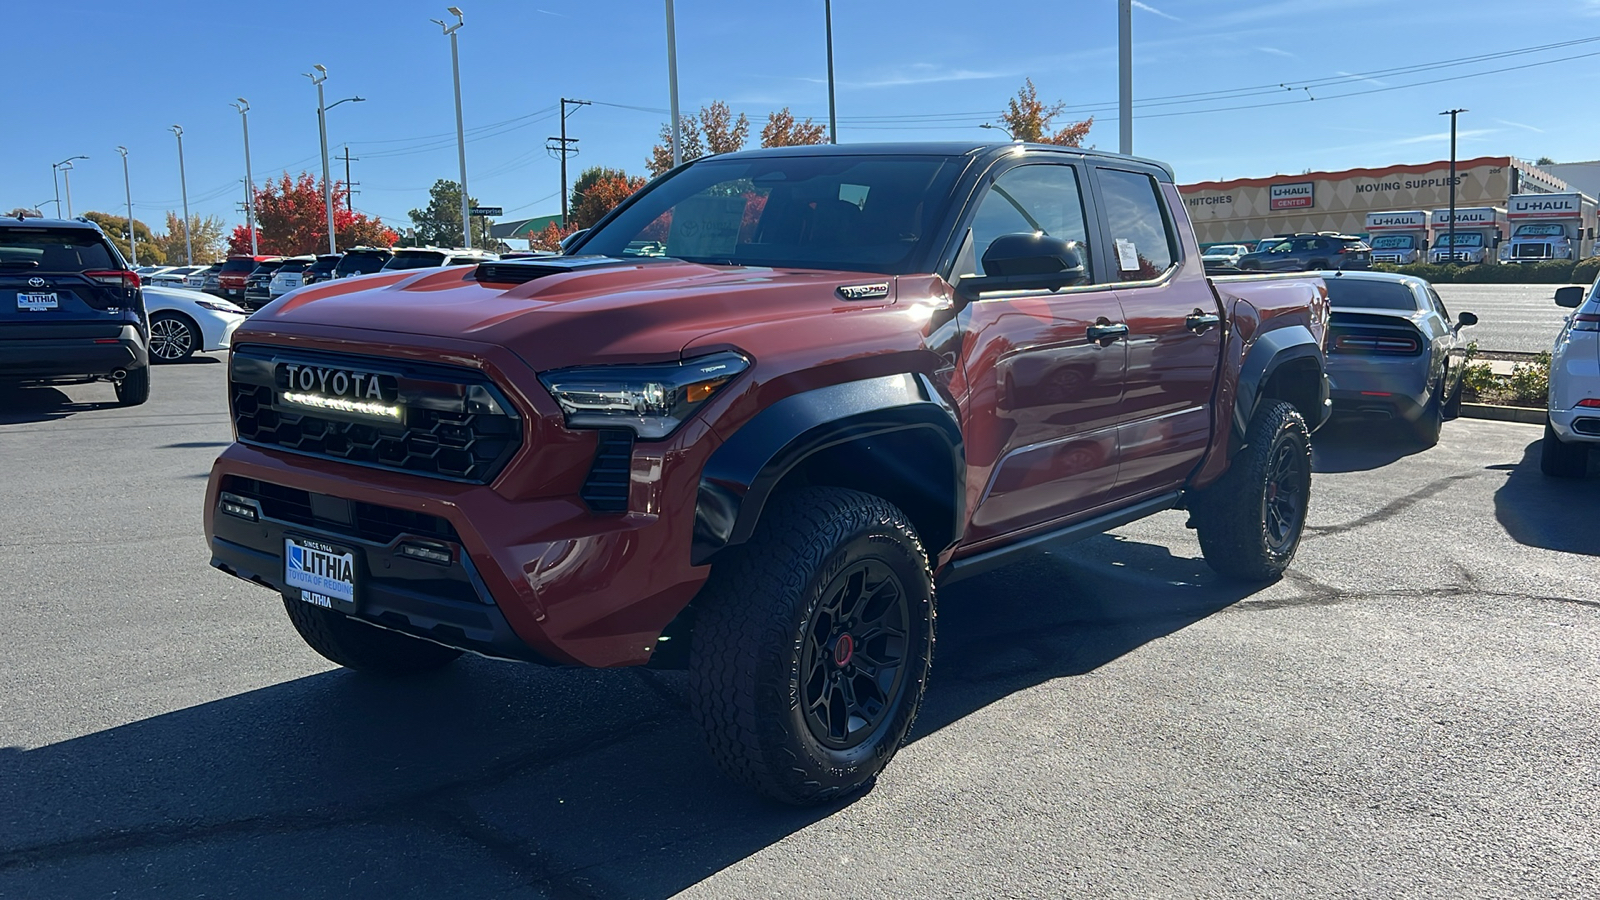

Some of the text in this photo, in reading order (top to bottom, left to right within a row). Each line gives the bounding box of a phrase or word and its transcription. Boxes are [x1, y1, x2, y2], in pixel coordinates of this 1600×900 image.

[1355, 175, 1461, 193] MOVING SUPPLIES
[1274, 187, 1310, 196] U-HAUL
[1189, 195, 1232, 206] HITCHES
[1277, 199, 1306, 207] CENTER
[1516, 201, 1572, 210] U-HAUL
[1373, 217, 1416, 226] U-HAUL
[1440, 214, 1485, 222] UHAUL
[27, 295, 56, 303] LITHIA
[286, 363, 382, 400] TOYOTA
[303, 540, 333, 553] SINCE 1946
[302, 549, 353, 585] LITHIA
[289, 569, 353, 596] TOYOTA OF REDDING
[308, 592, 332, 608] LITHIA
